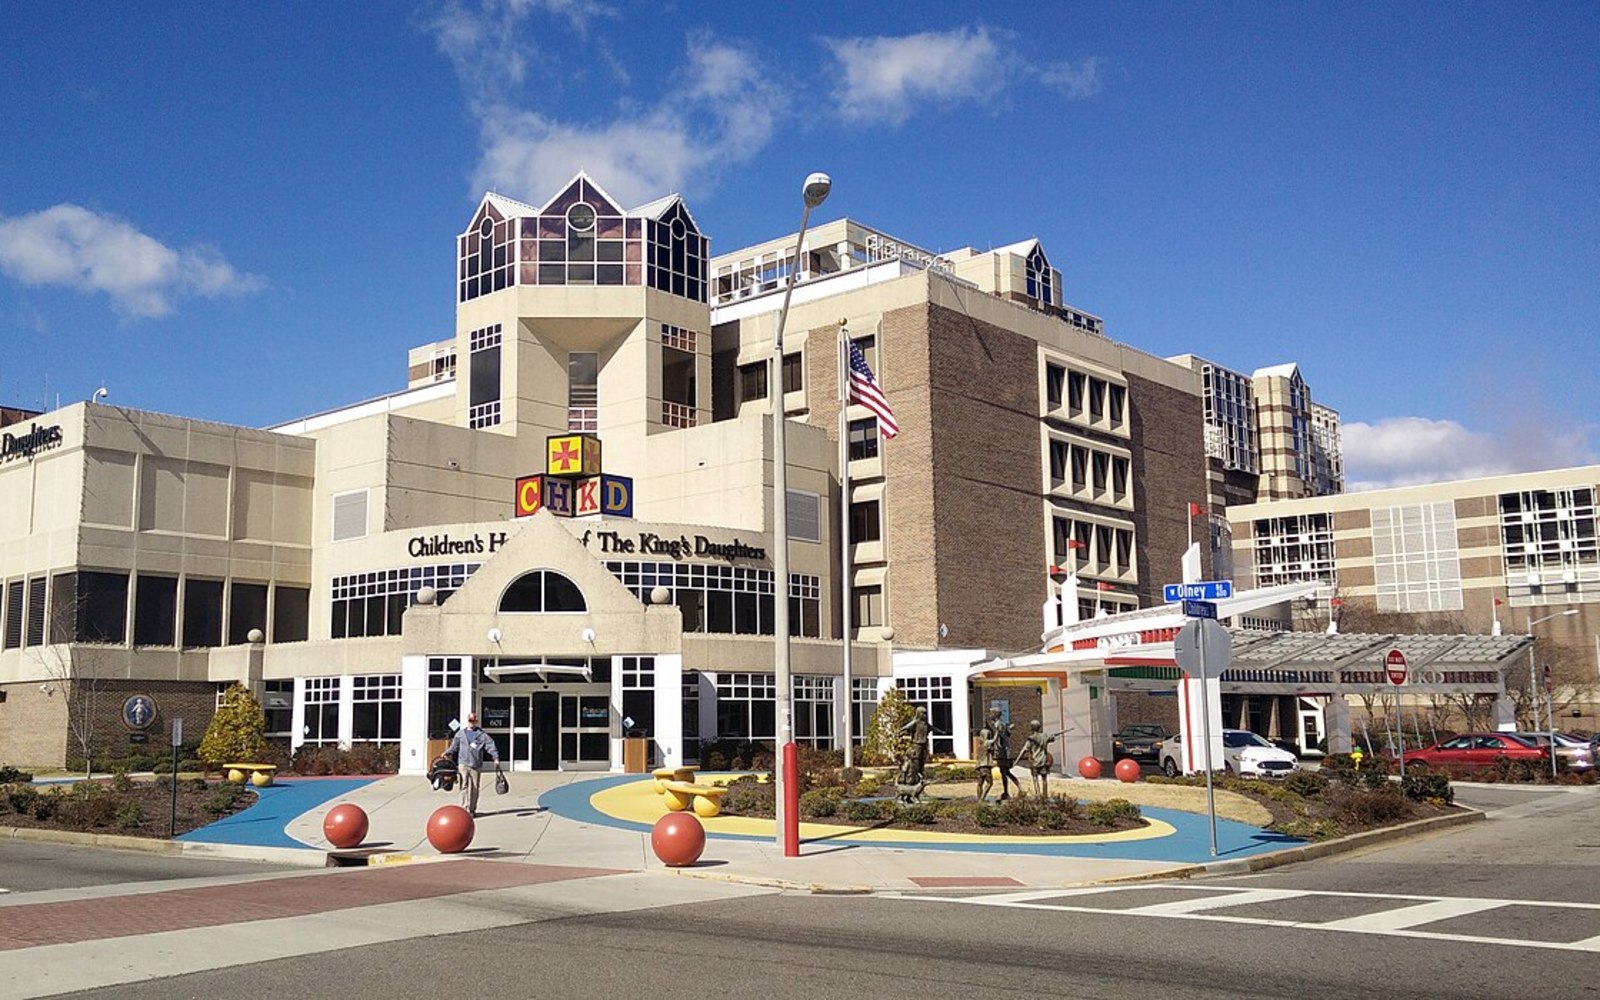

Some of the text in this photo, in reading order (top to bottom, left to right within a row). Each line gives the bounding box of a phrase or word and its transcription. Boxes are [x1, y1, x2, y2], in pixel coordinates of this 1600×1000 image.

[521, 481, 628, 512] CHKD
[408, 533, 484, 557] Children's
[596, 531, 634, 553] The
[638, 533, 690, 559] King's
[694, 535, 766, 561] Daughters
[1177, 583, 1206, 600] Olney
